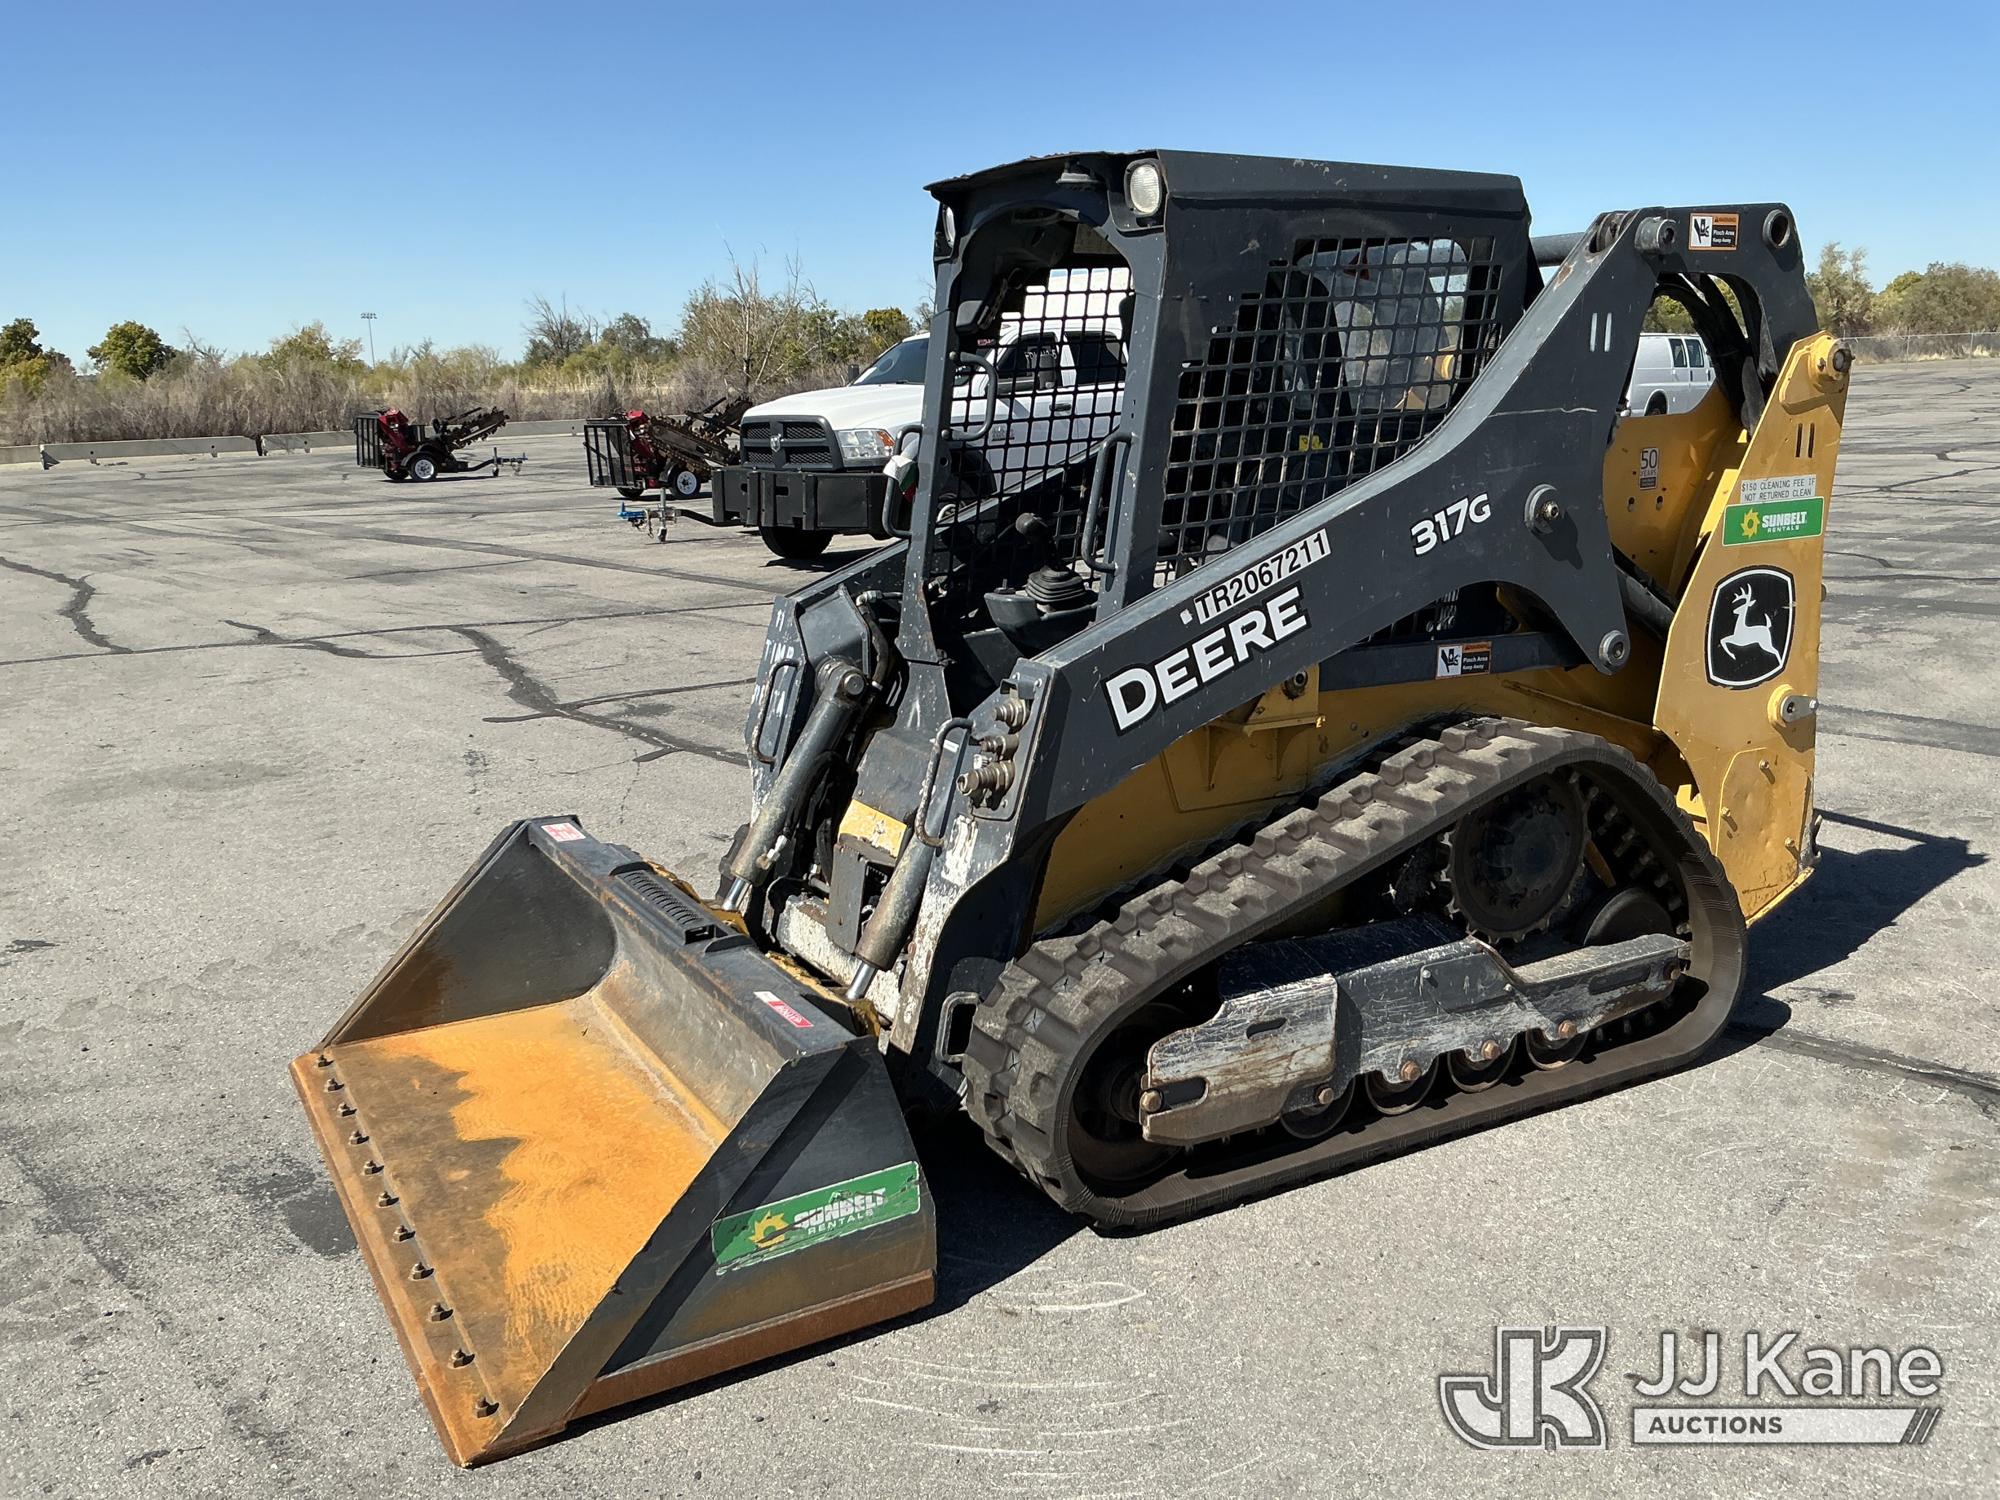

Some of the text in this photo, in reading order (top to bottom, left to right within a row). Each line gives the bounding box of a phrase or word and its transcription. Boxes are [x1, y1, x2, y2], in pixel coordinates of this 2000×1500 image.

[1641, 449, 1658, 470] 50
[1741, 477, 1816, 492] $150 CLEANING FEE IF
[1744, 488, 1812, 501] NOT RETURNED CLEAN
[1411, 493, 1491, 555] 317G
[1761, 511, 1807, 528] SUNBELT
[1767, 525, 1800, 533] RENTALS
[1195, 533, 1328, 619] TR2067211
[1105, 586, 1307, 731] DEERE
[793, 1187, 887, 1229] SUNBELT
[808, 1209, 874, 1236] RENTALS
